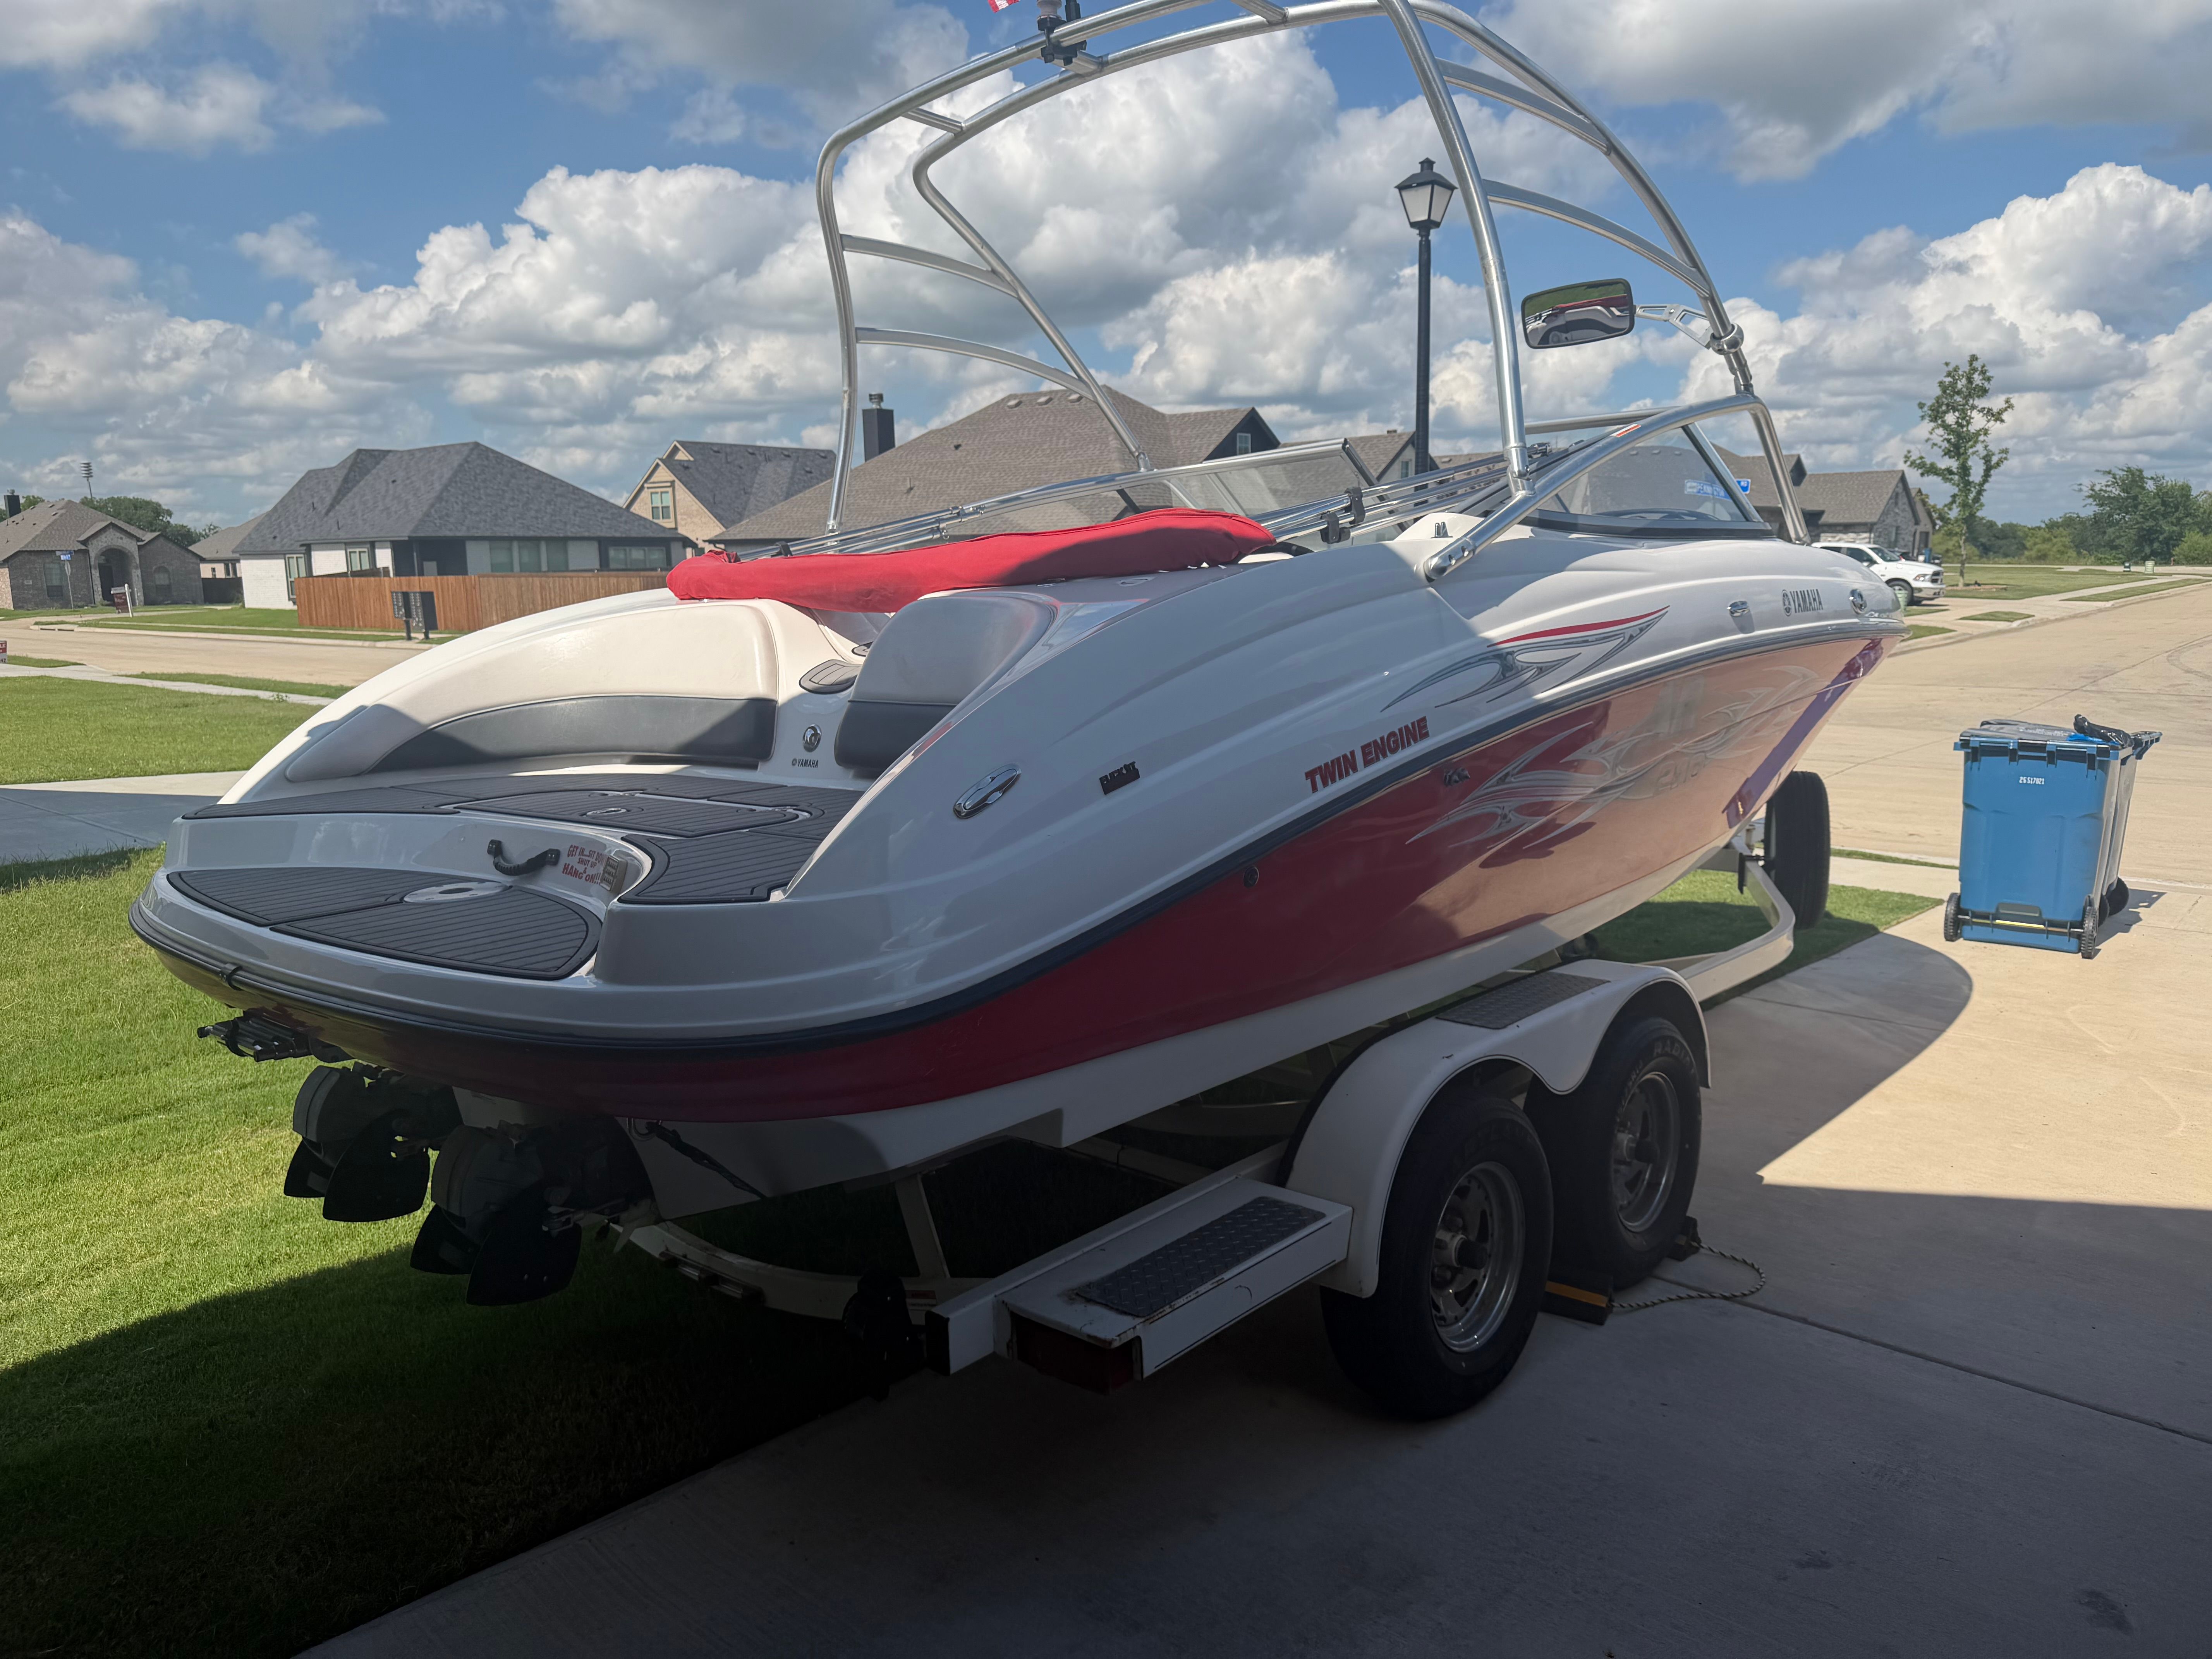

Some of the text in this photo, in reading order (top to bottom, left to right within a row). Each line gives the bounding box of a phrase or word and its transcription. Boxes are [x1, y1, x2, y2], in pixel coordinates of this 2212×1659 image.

[1790, 589, 1823, 613] YAMAHA
[1305, 715, 1430, 793] TWIN ENGINE
[798, 759, 818, 768] YAMAHA
[567, 845, 579, 857] GET
[577, 857, 590, 867] SHUT
[562, 863, 583, 879] HANG
